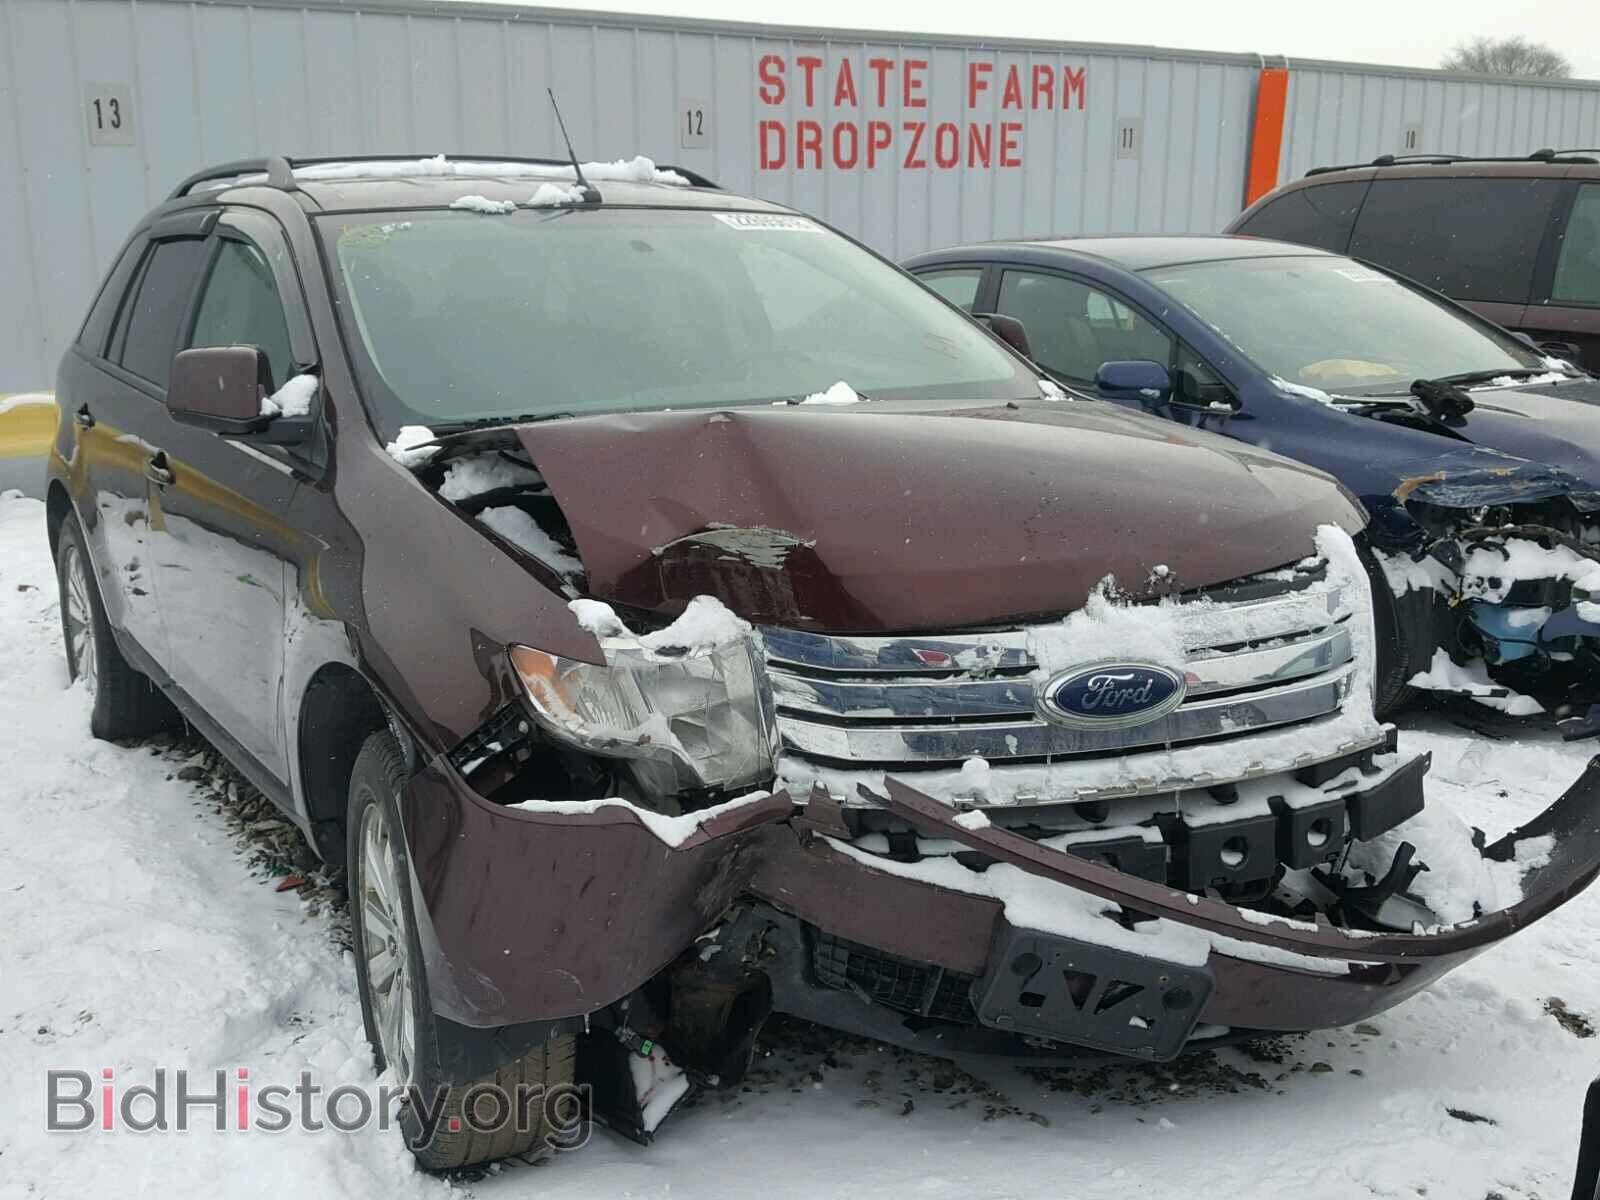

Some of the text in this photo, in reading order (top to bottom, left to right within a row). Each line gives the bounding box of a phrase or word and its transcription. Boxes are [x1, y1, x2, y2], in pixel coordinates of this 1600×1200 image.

[758, 54, 1085, 110] STATE FARM
[93, 98, 121, 129] 13
[687, 110, 703, 135] 12
[759, 120, 1023, 170] DROPZONE
[1122, 127, 1133, 149] 11
[1081, 673, 1153, 710] Ford
